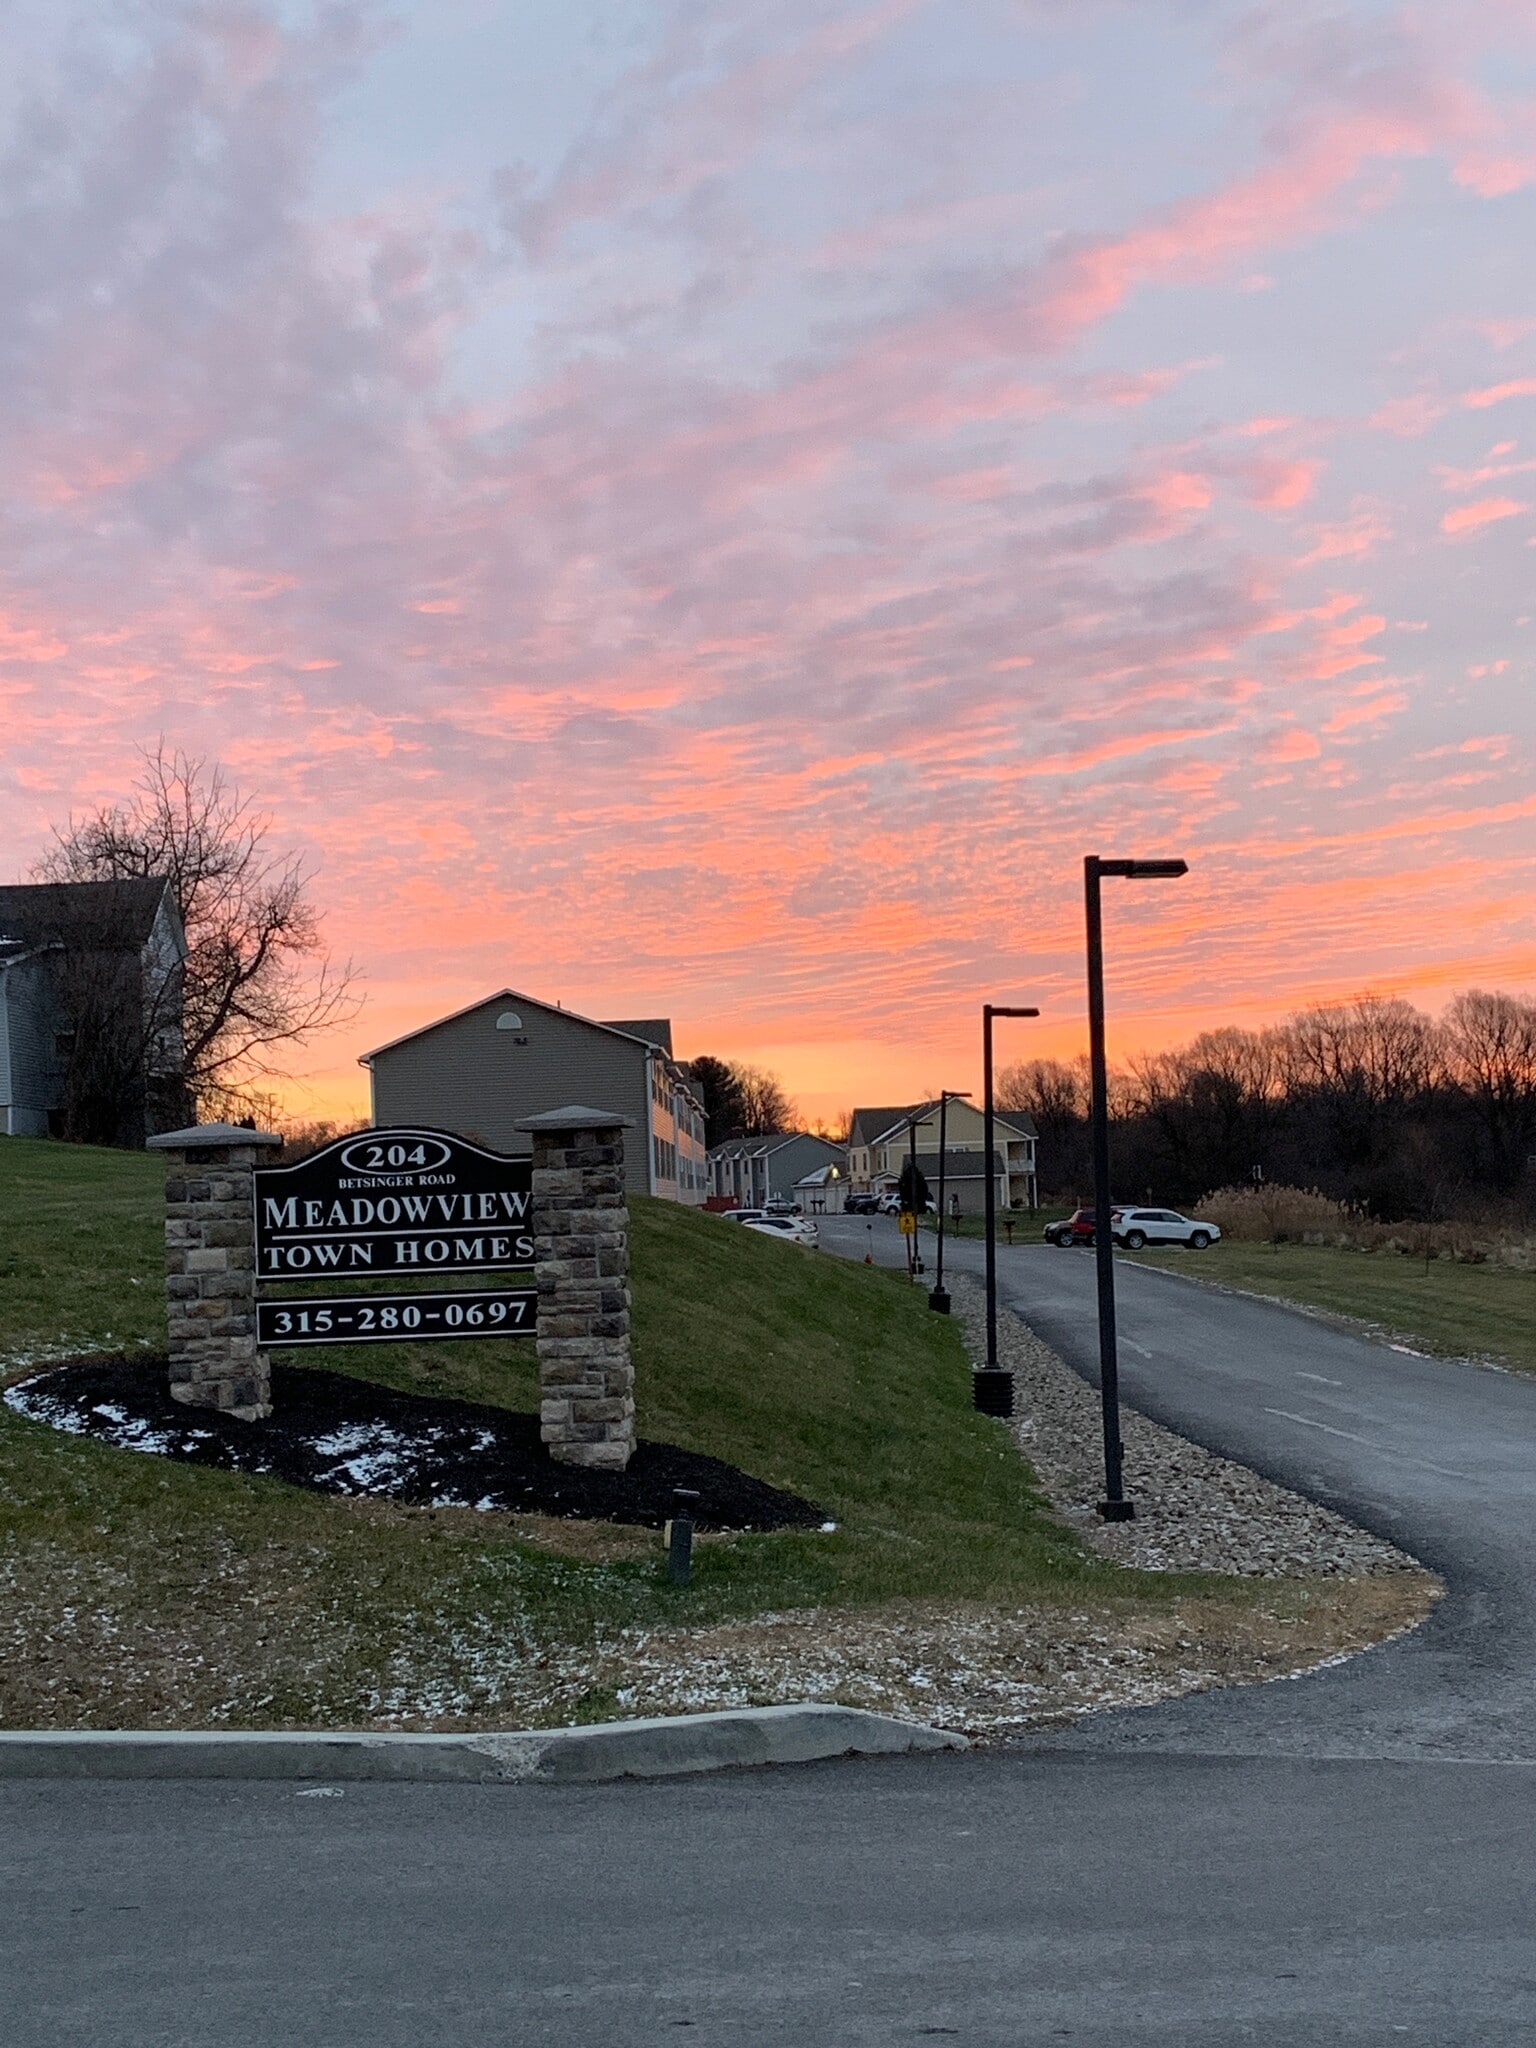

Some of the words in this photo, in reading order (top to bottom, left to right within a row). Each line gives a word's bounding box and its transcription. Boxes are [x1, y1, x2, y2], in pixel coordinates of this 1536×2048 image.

[366, 1144, 426, 1168] 204
[338, 1176, 414, 1189] BETSINGER
[418, 1173, 456, 1186] ROAD
[263, 1191, 532, 1229] MEADOWVIEW
[263, 1242, 373, 1269] TOWN
[394, 1236, 534, 1264] HOMES
[274, 1301, 527, 1334] 315-280-0697
